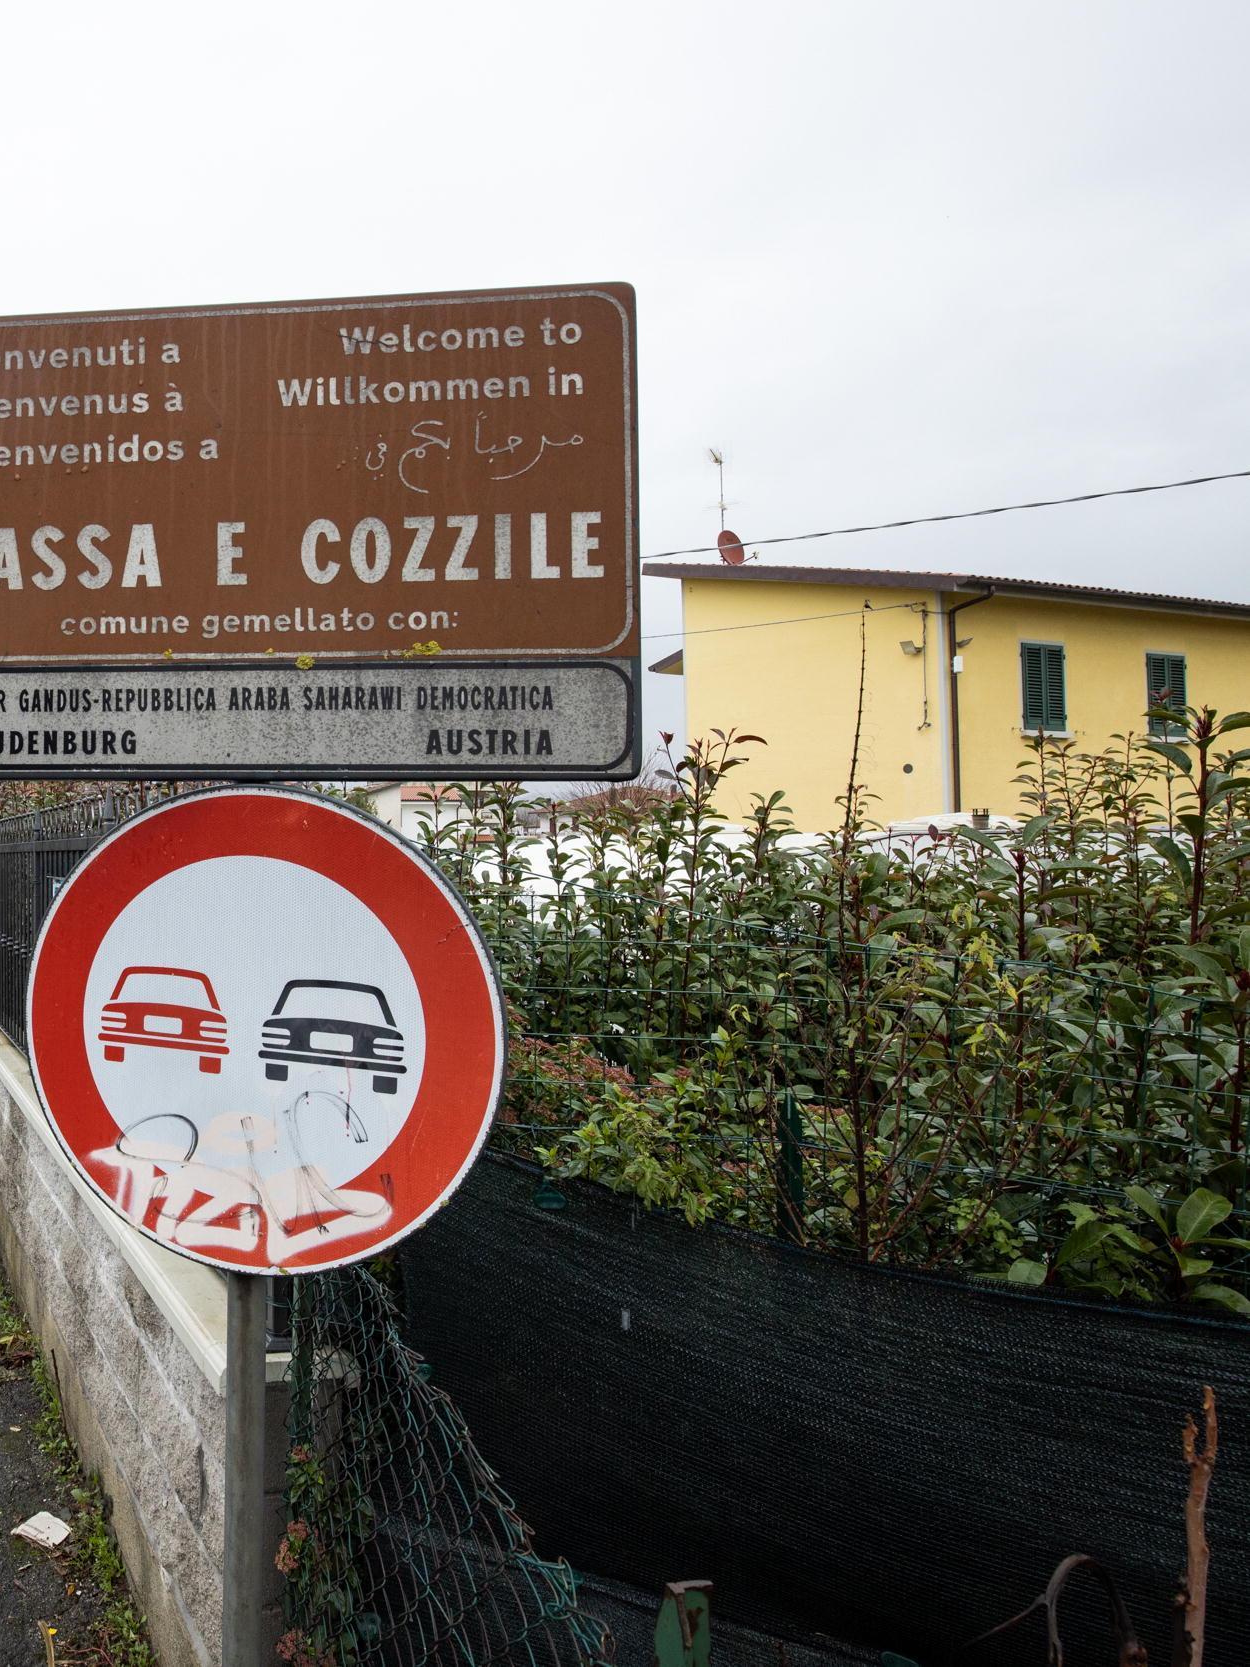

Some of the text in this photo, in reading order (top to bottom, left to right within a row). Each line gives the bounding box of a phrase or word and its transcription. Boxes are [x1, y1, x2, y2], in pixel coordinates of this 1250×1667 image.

[340, 318, 582, 355] Welcome to
[161, 343, 180, 363] a
[164, 381, 183, 411] à
[278, 366, 583, 406] Willkommen in
[199, 439, 218, 460] a
[365, 434, 388, 480] في
[397, 420, 451, 494] بكم
[217, 522, 247, 585] E
[301, 511, 604, 584] COZZILE
[61, 607, 458, 638] comune gemellato con:
[20, 688, 216, 712] GANDUS-REPUBBLICA
[229, 687, 290, 710] ARABA
[304, 687, 401, 710] SAHARAWI
[417, 686, 553, 711] DEMOCRATICA
[426, 729, 552, 755] AUSTRIA
